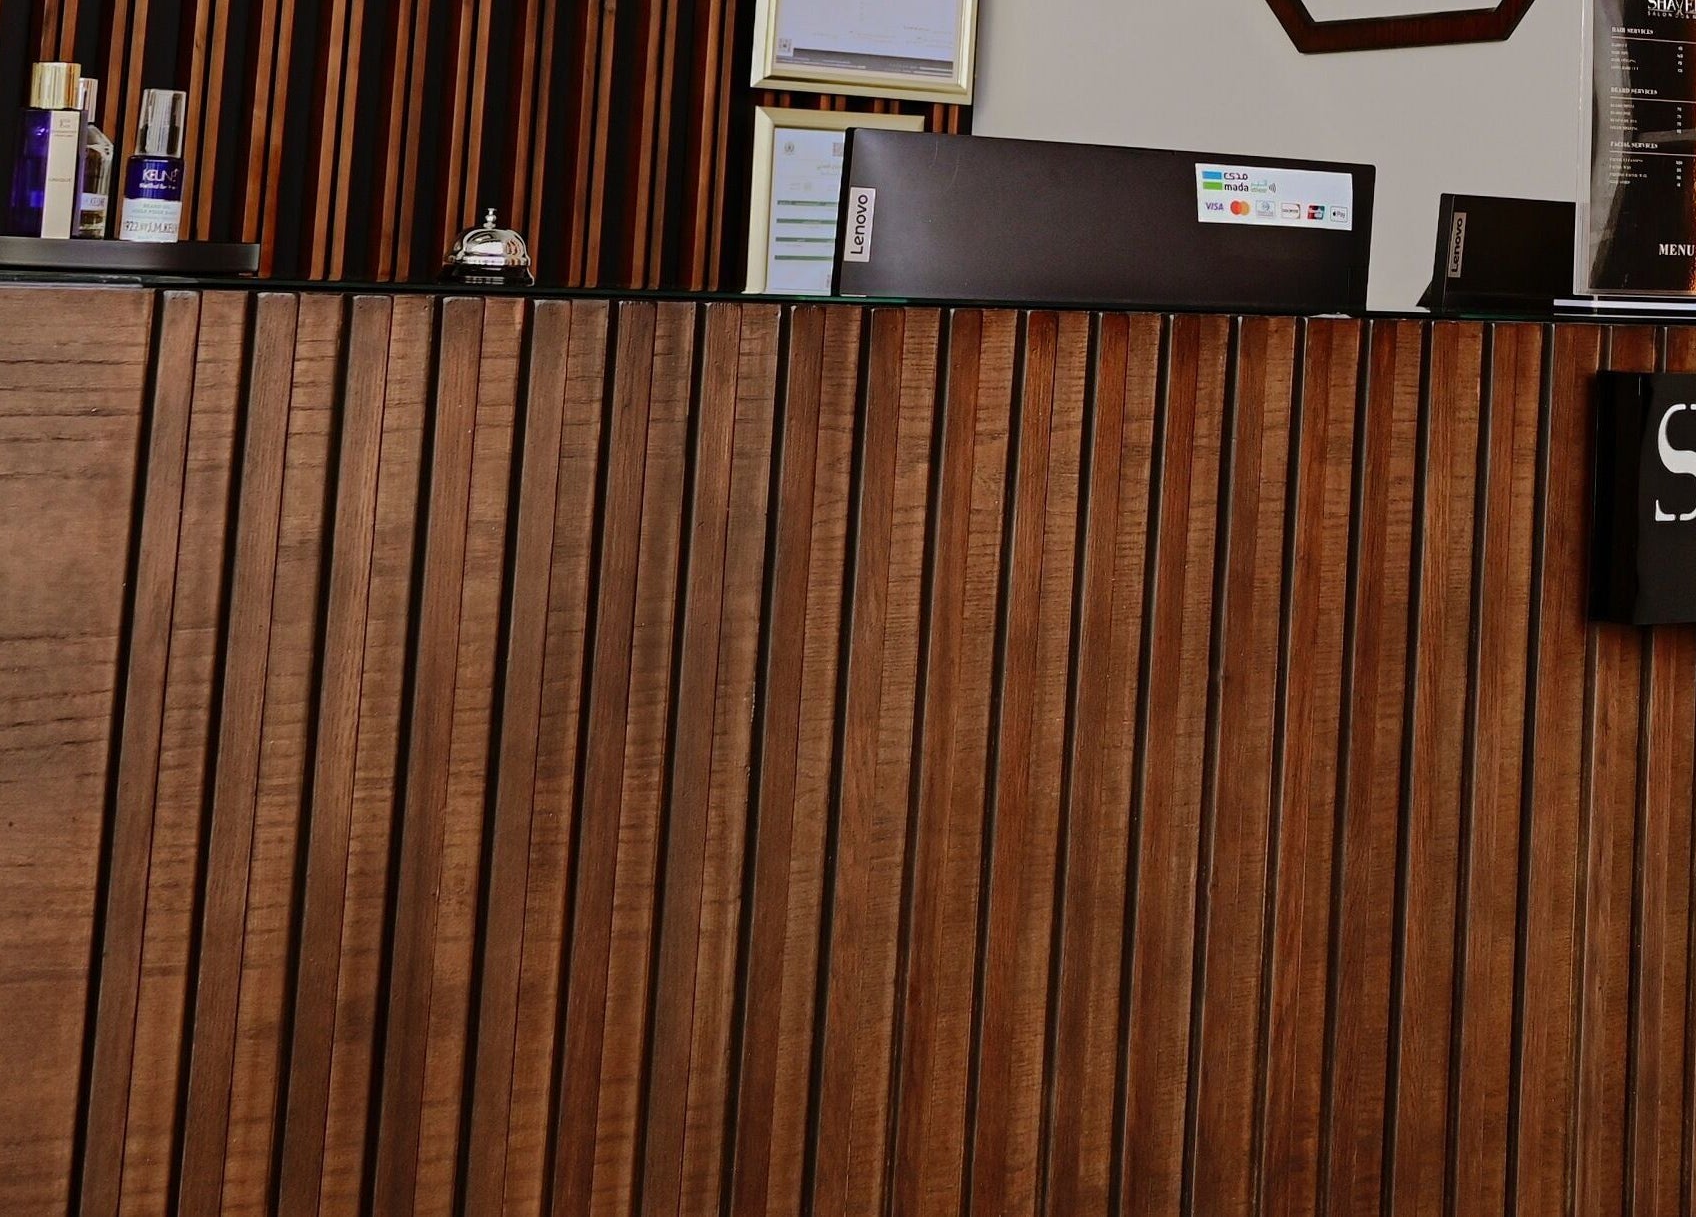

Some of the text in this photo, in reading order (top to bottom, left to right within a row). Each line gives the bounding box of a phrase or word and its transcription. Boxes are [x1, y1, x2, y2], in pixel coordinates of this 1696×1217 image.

[1224, 182, 1249, 192] mada
[1206, 201, 1224, 212] VISA
[850, 193, 869, 255] Lenovo
[1451, 217, 1464, 273] Lenovo
[1658, 244, 1695, 257] MENU
